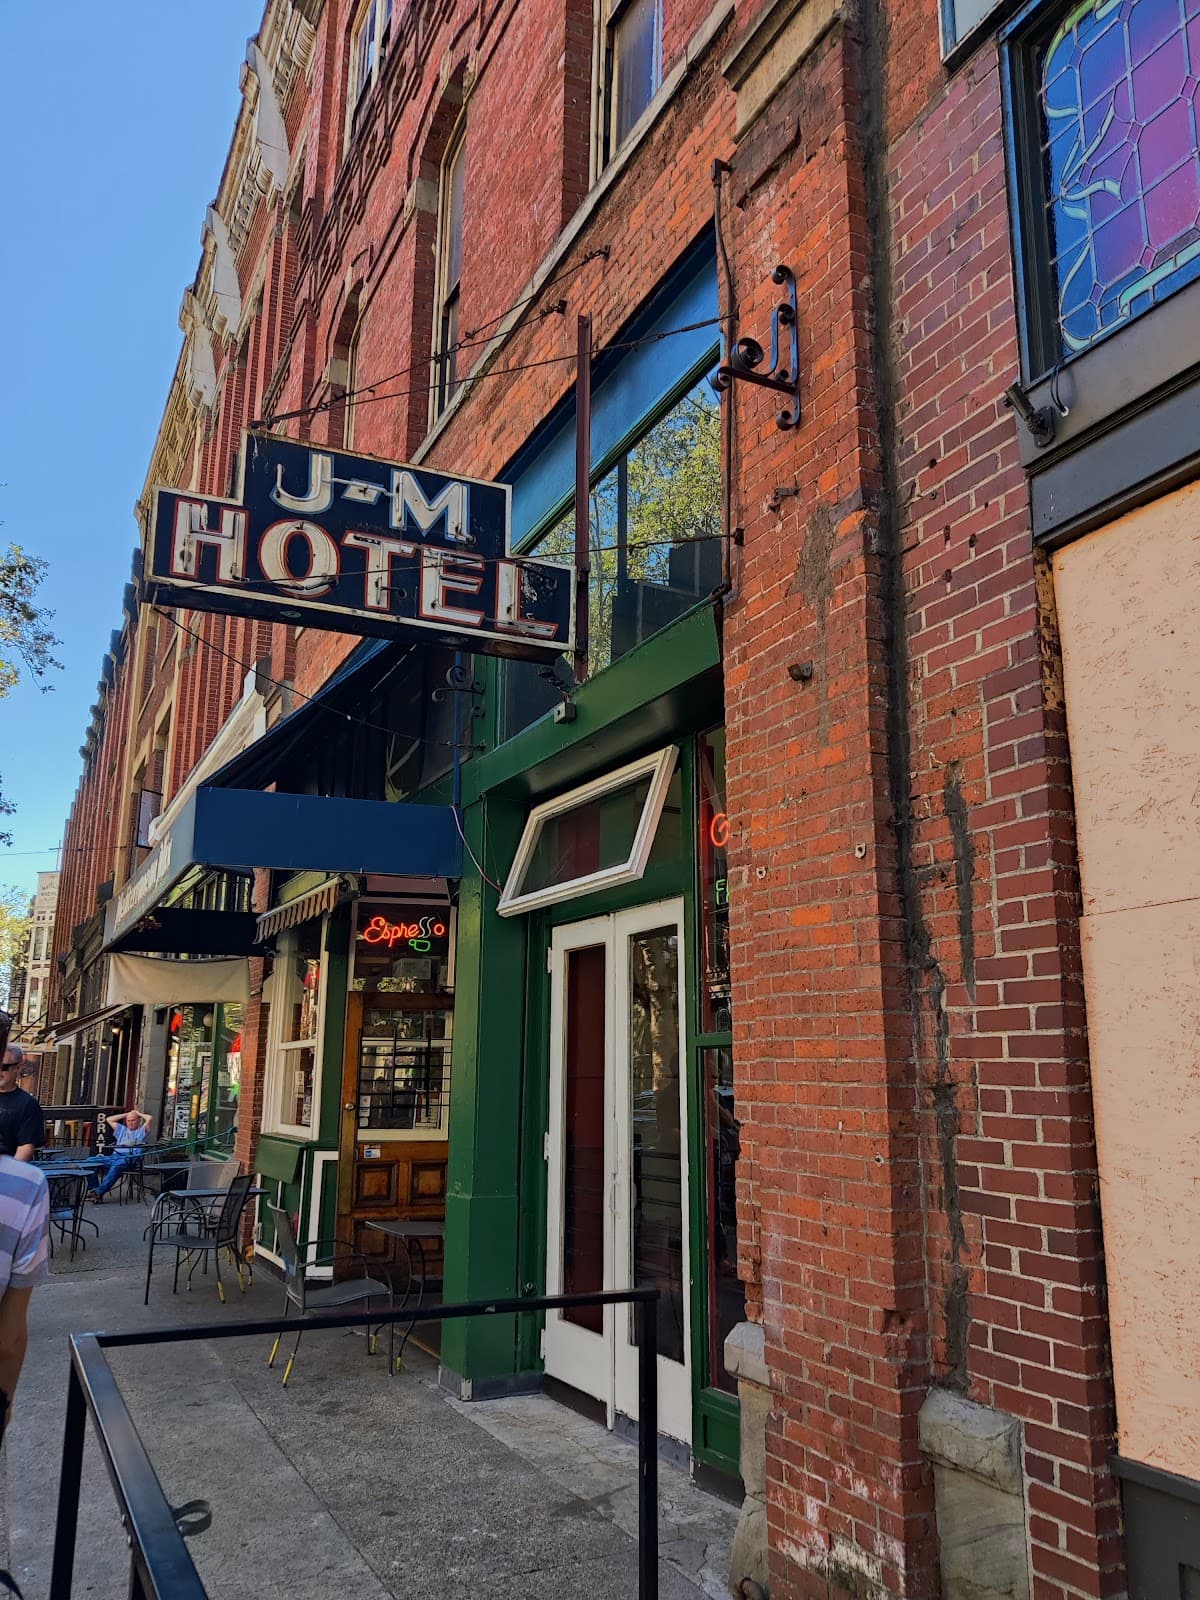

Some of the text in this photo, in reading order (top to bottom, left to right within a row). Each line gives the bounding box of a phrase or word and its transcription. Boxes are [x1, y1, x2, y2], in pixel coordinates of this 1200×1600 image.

[270, 452, 474, 541] J-M
[169, 498, 560, 638] HOTEL
[363, 915, 445, 948] Espresso
